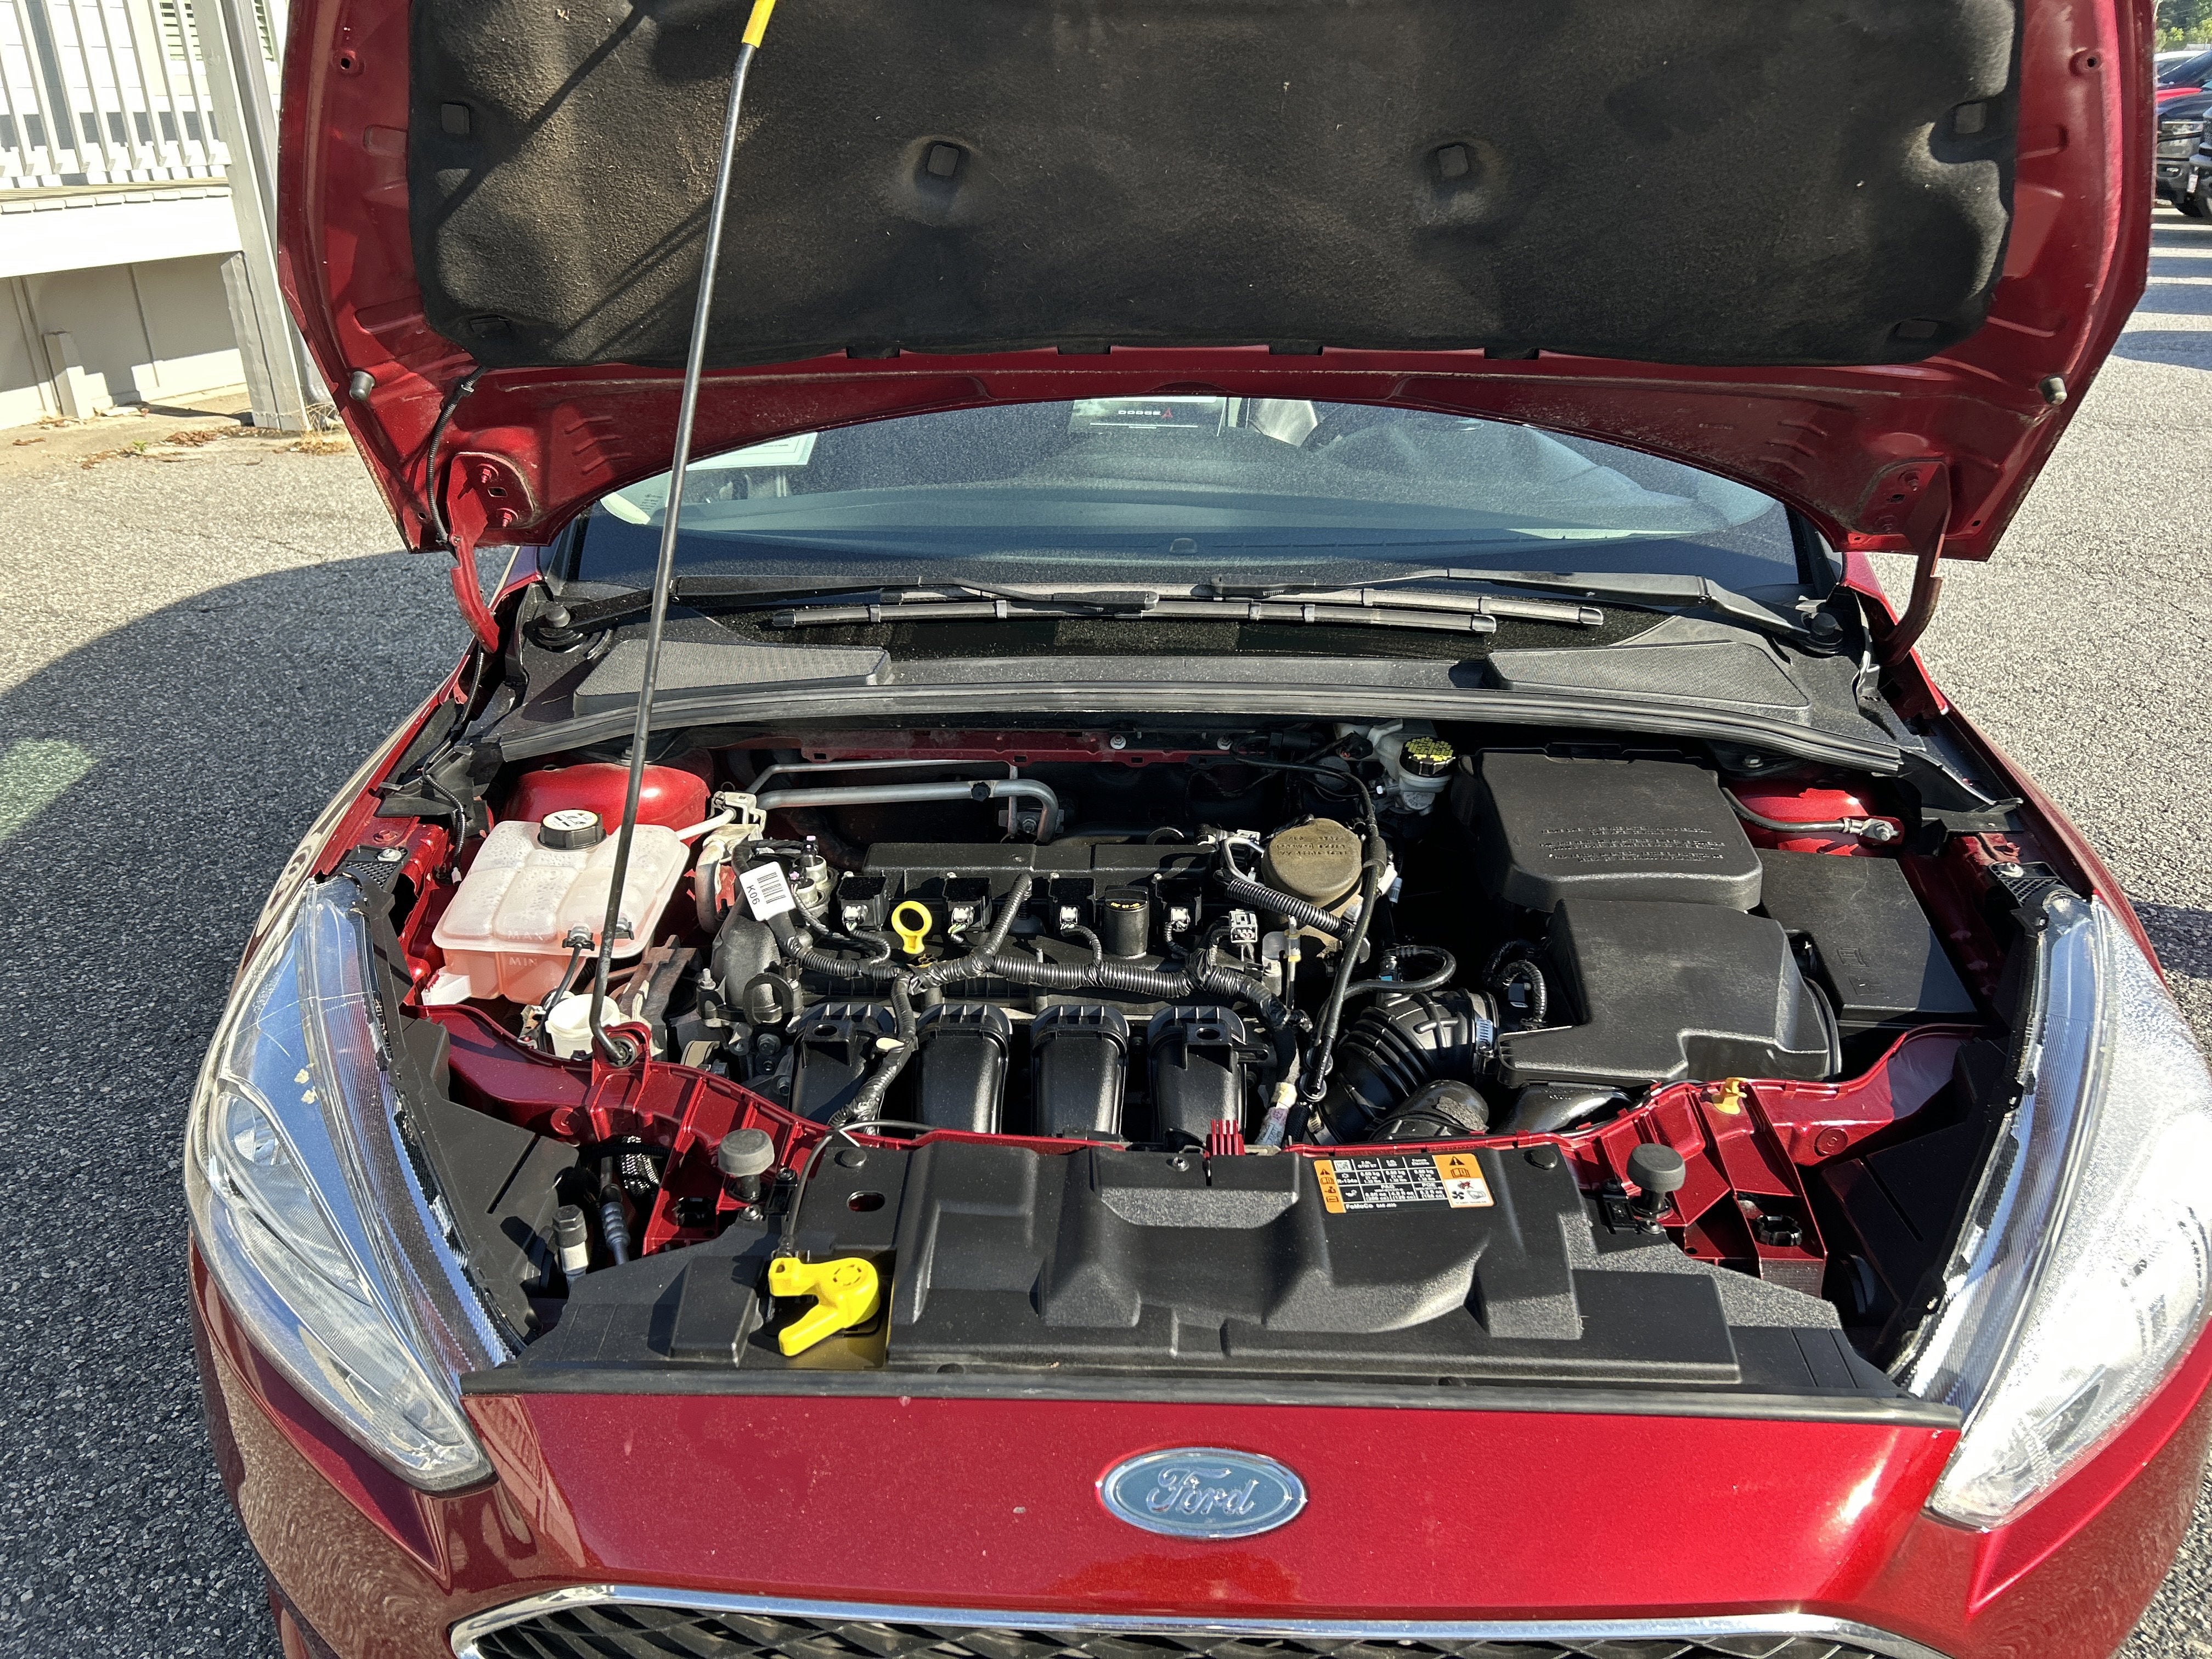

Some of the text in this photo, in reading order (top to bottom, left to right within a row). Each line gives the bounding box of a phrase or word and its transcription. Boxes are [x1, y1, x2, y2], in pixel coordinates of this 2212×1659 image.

[746, 884, 760, 905] K06
[509, 957, 538, 967] MIN
[1146, 1466, 1259, 1515] Ford
